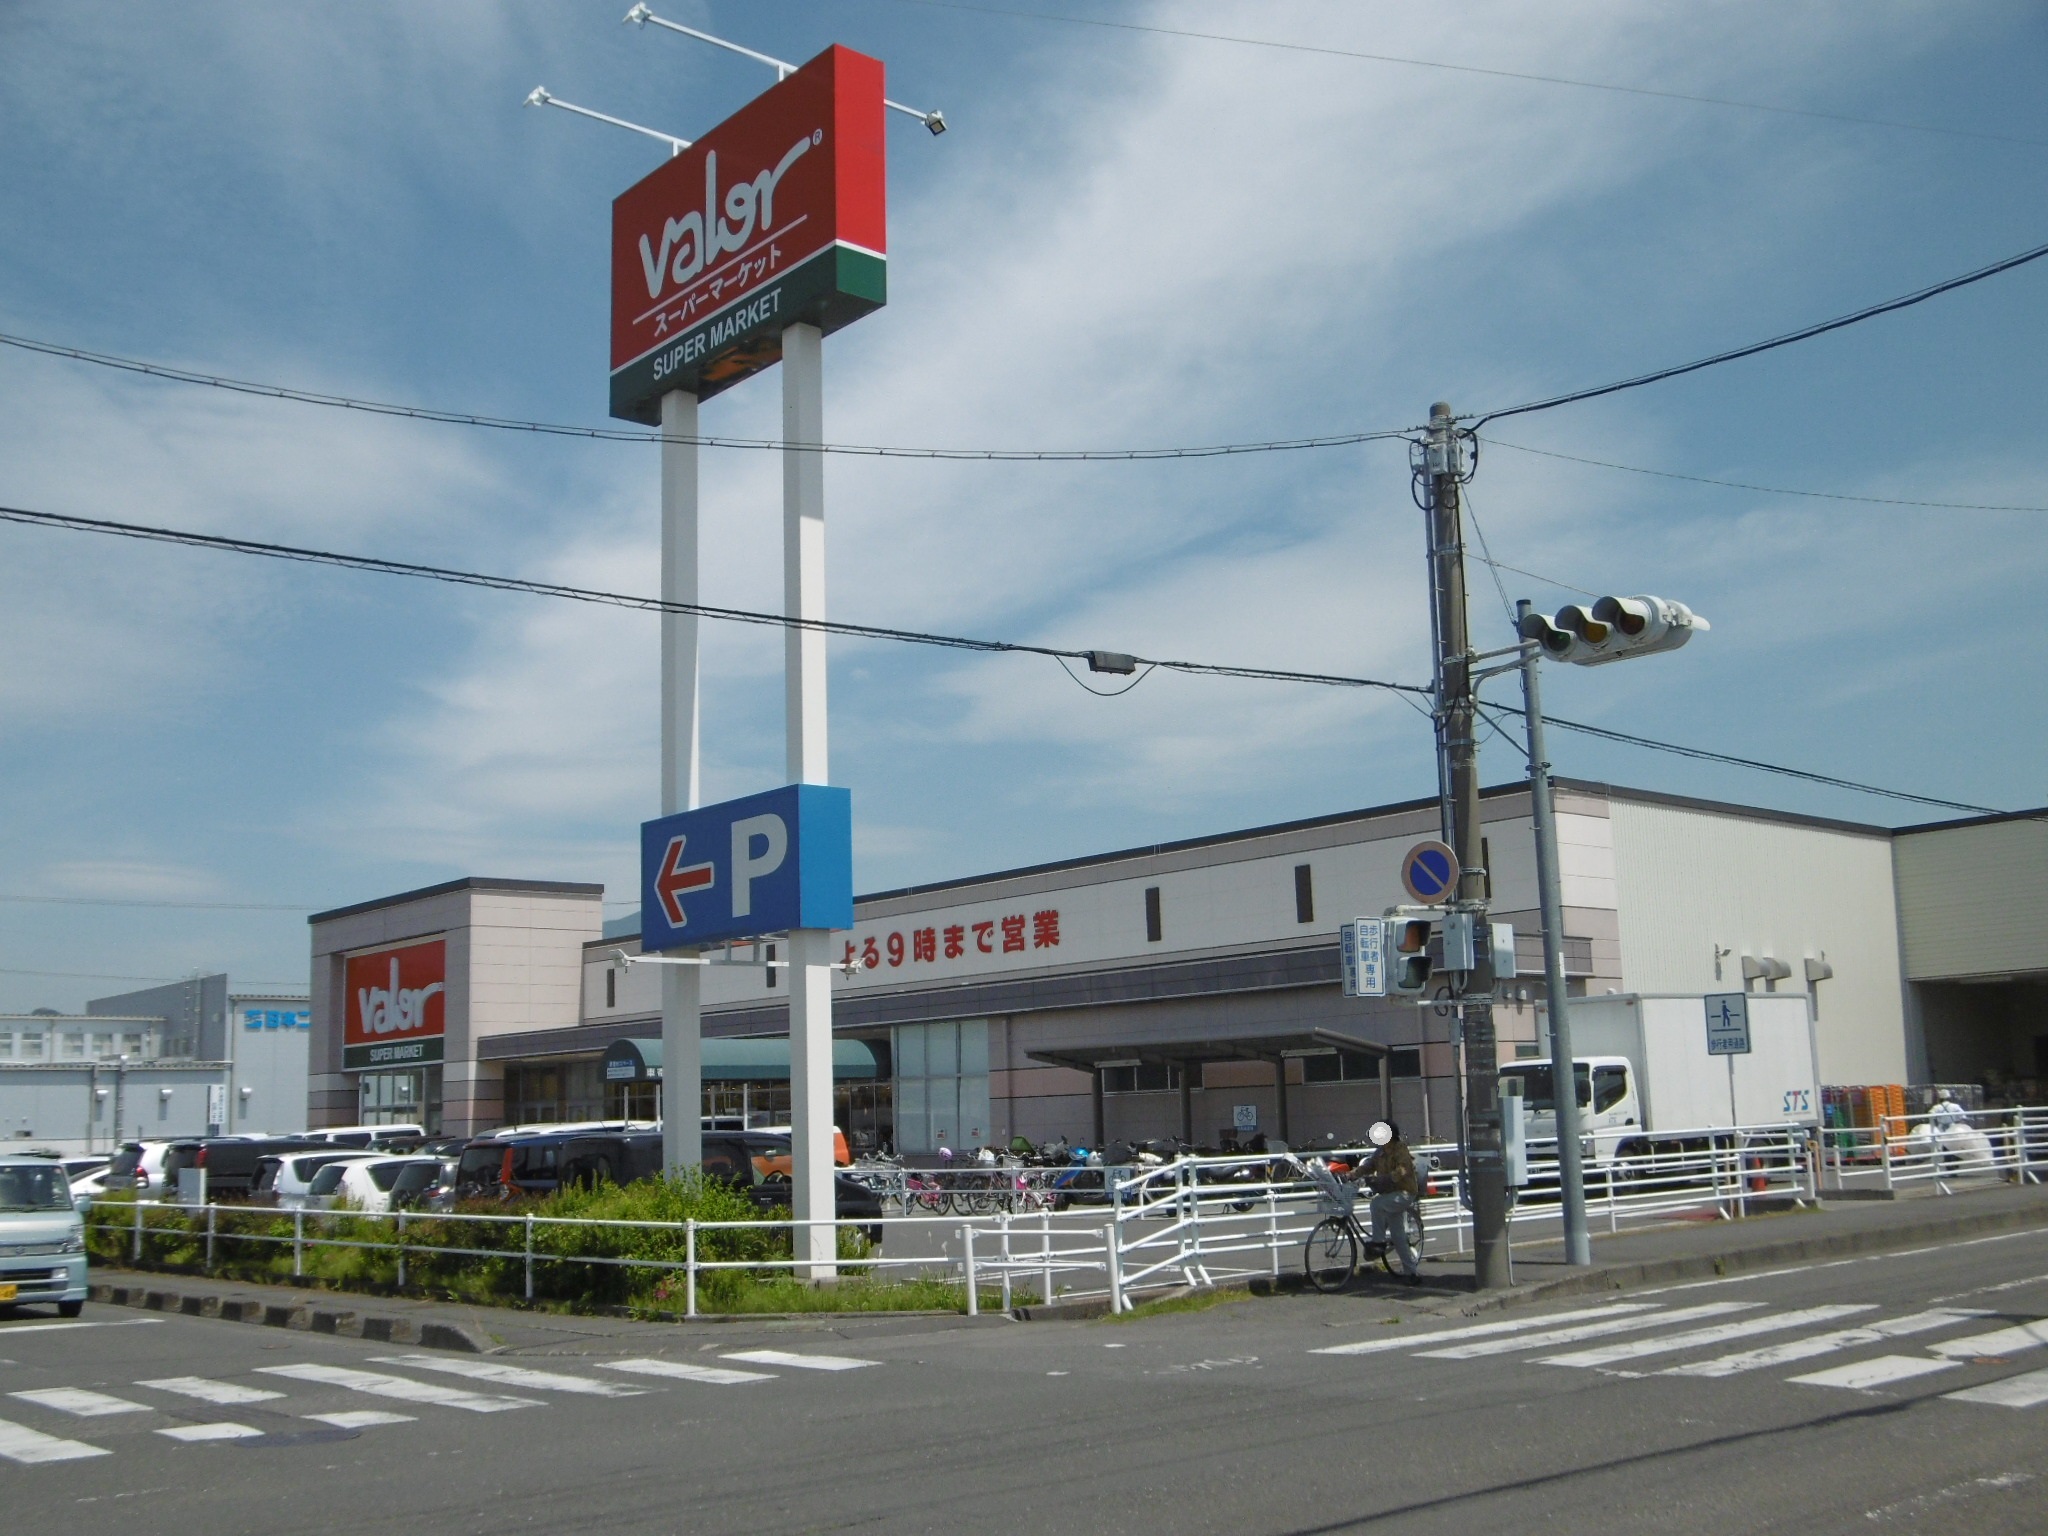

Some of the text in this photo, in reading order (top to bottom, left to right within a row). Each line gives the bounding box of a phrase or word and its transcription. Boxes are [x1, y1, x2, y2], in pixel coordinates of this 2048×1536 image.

[654, 244, 782, 337] スーパーマーケット
[653, 287, 782, 381] SUPER MARKET
[731, 813, 788, 918] P
[1369, 925, 1379, 962] 歩行者
[1365, 963, 1376, 989] 専用
[370, 1044, 424, 1062] SUPER MARKET
[1783, 1089, 1809, 1112] STS
